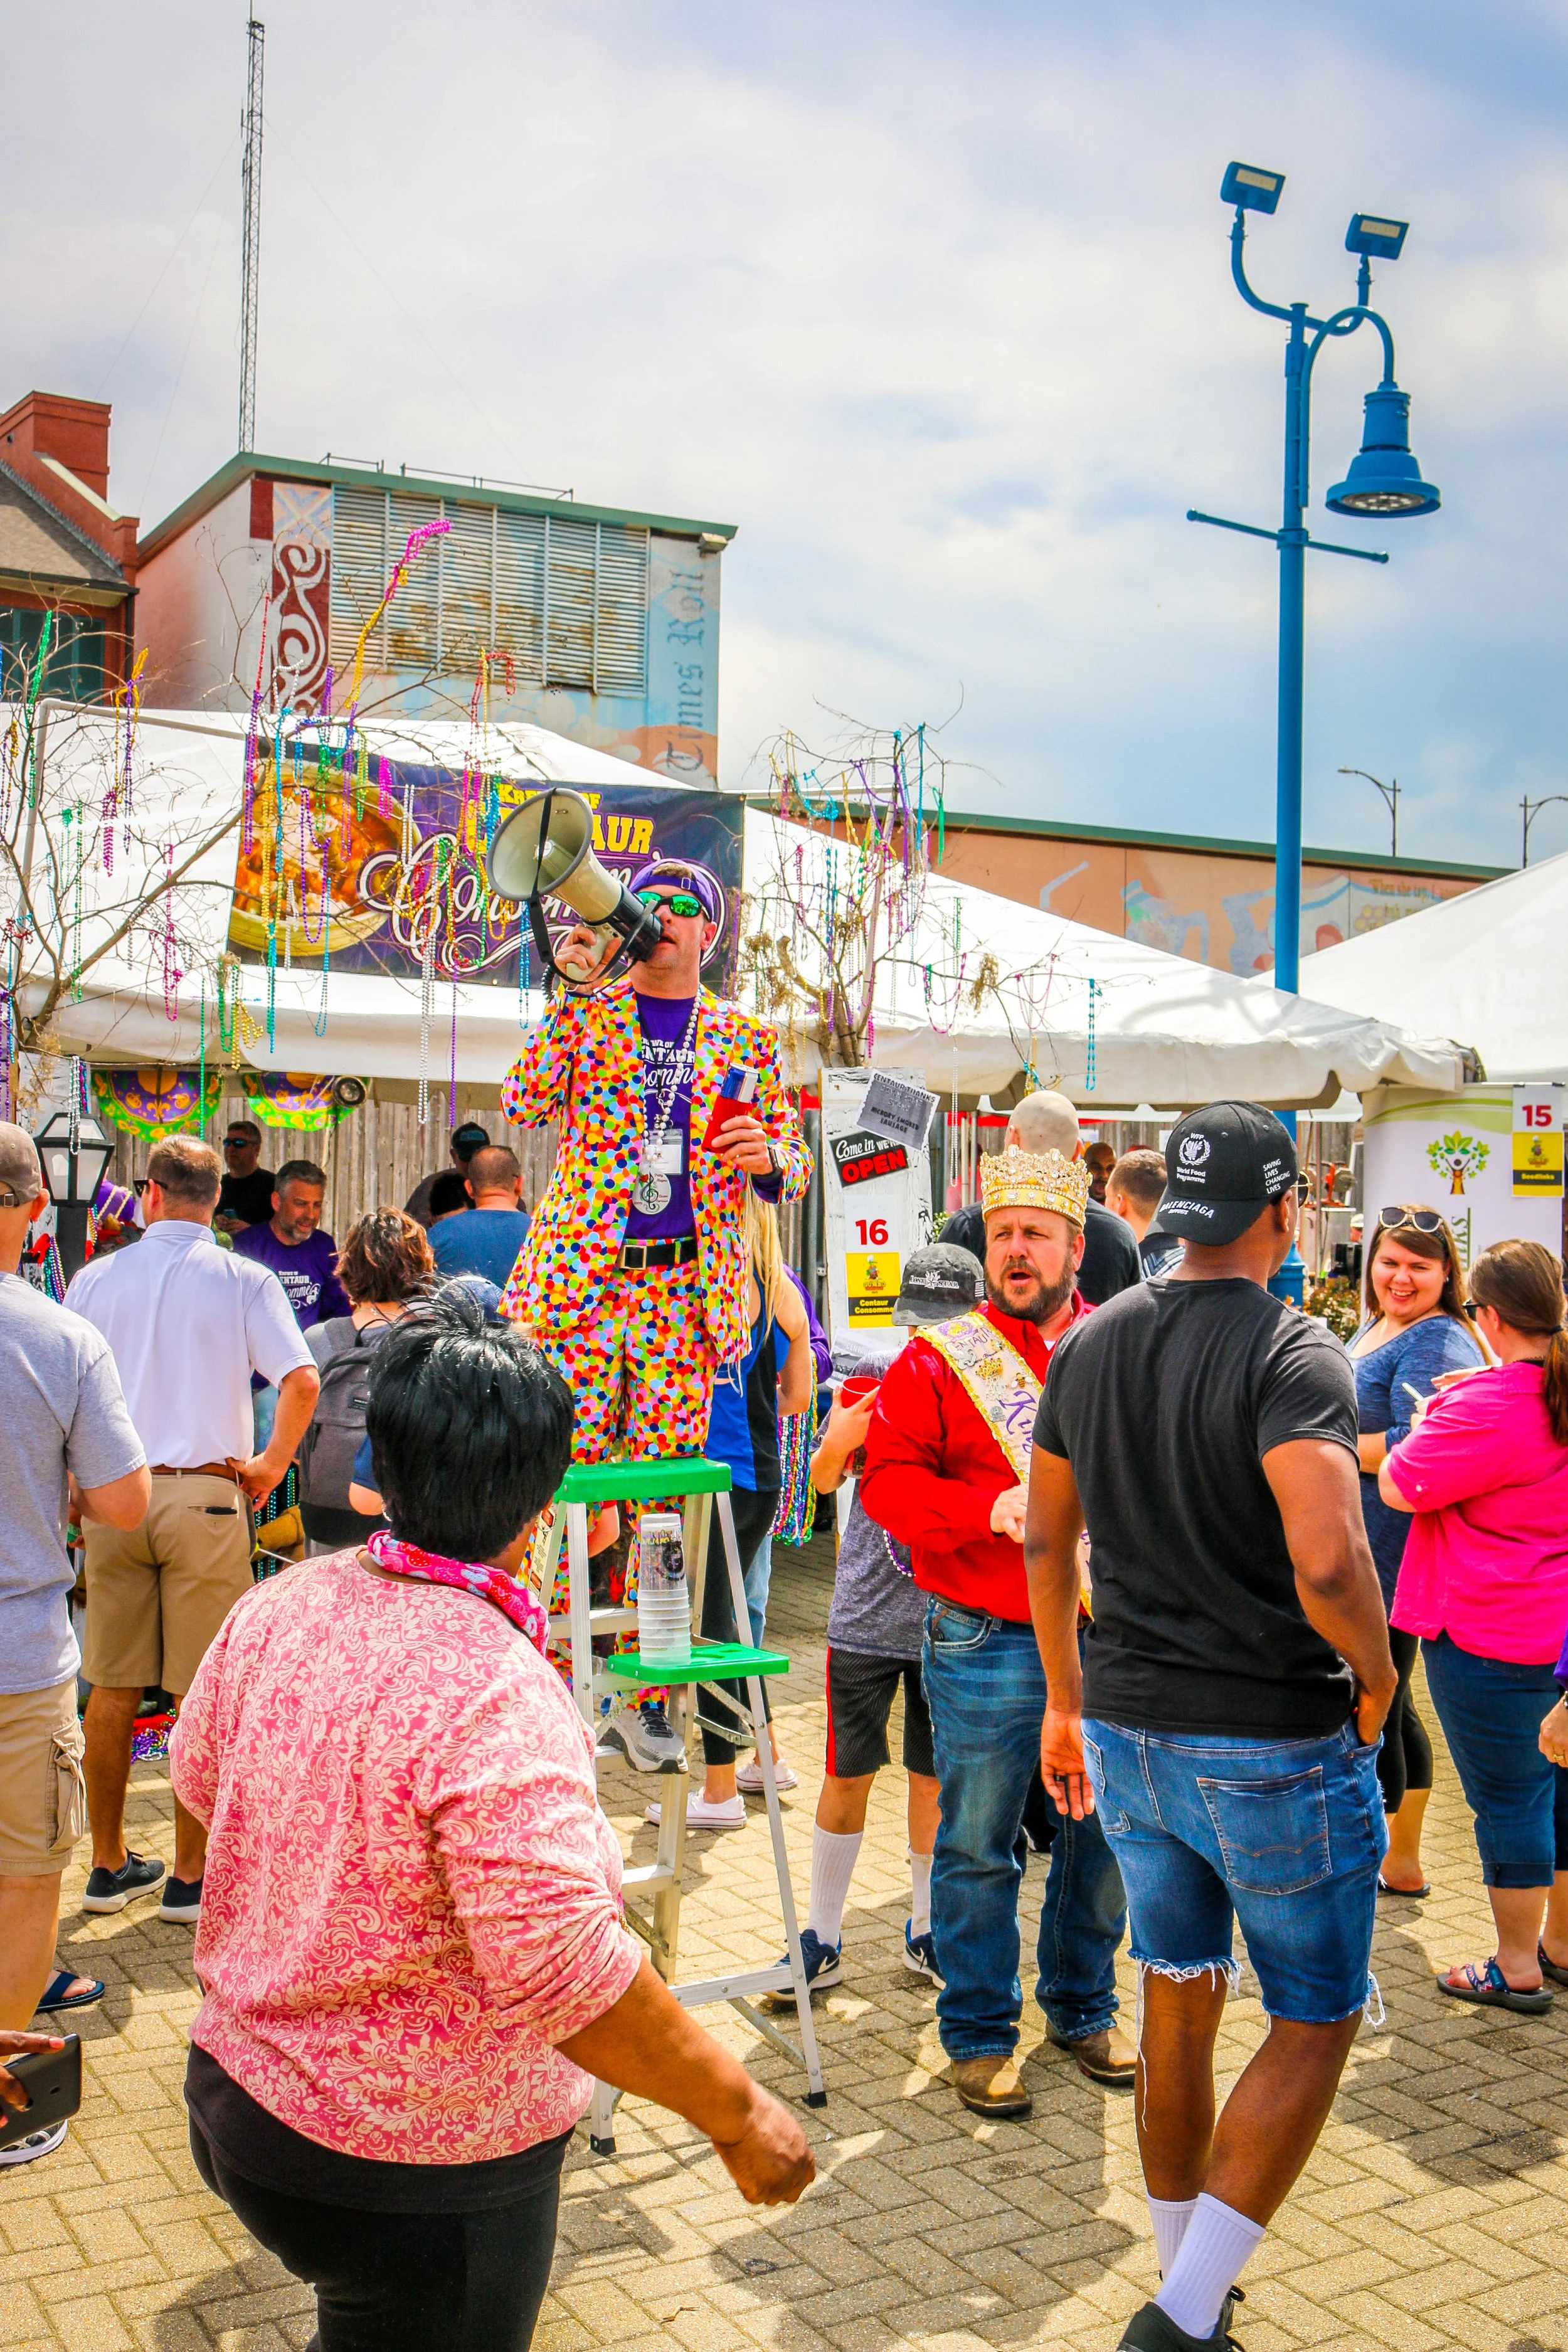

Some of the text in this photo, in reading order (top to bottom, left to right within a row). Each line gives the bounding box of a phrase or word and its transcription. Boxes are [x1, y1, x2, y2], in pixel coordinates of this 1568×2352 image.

[874, 1073, 935, 1103] CENTAUR THANKS
[1522, 1104, 1553, 1127] 15
[880, 1118, 908, 1133] SAUSAGE
[835, 1140, 863, 1159] Come
[864, 1139, 876, 1152] in
[842, 1148, 906, 1184] OPEN
[1263, 1158, 1281, 1171] SAVING
[1177, 1173, 1205, 1184] Programme
[1264, 1168, 1278, 1179] LIVES
[1266, 1171, 1290, 1186] CHANGING
[1266, 1184, 1281, 1194] LIVES
[855, 1219, 889, 1245] 16
[911, 1275, 925, 1284] LONE
